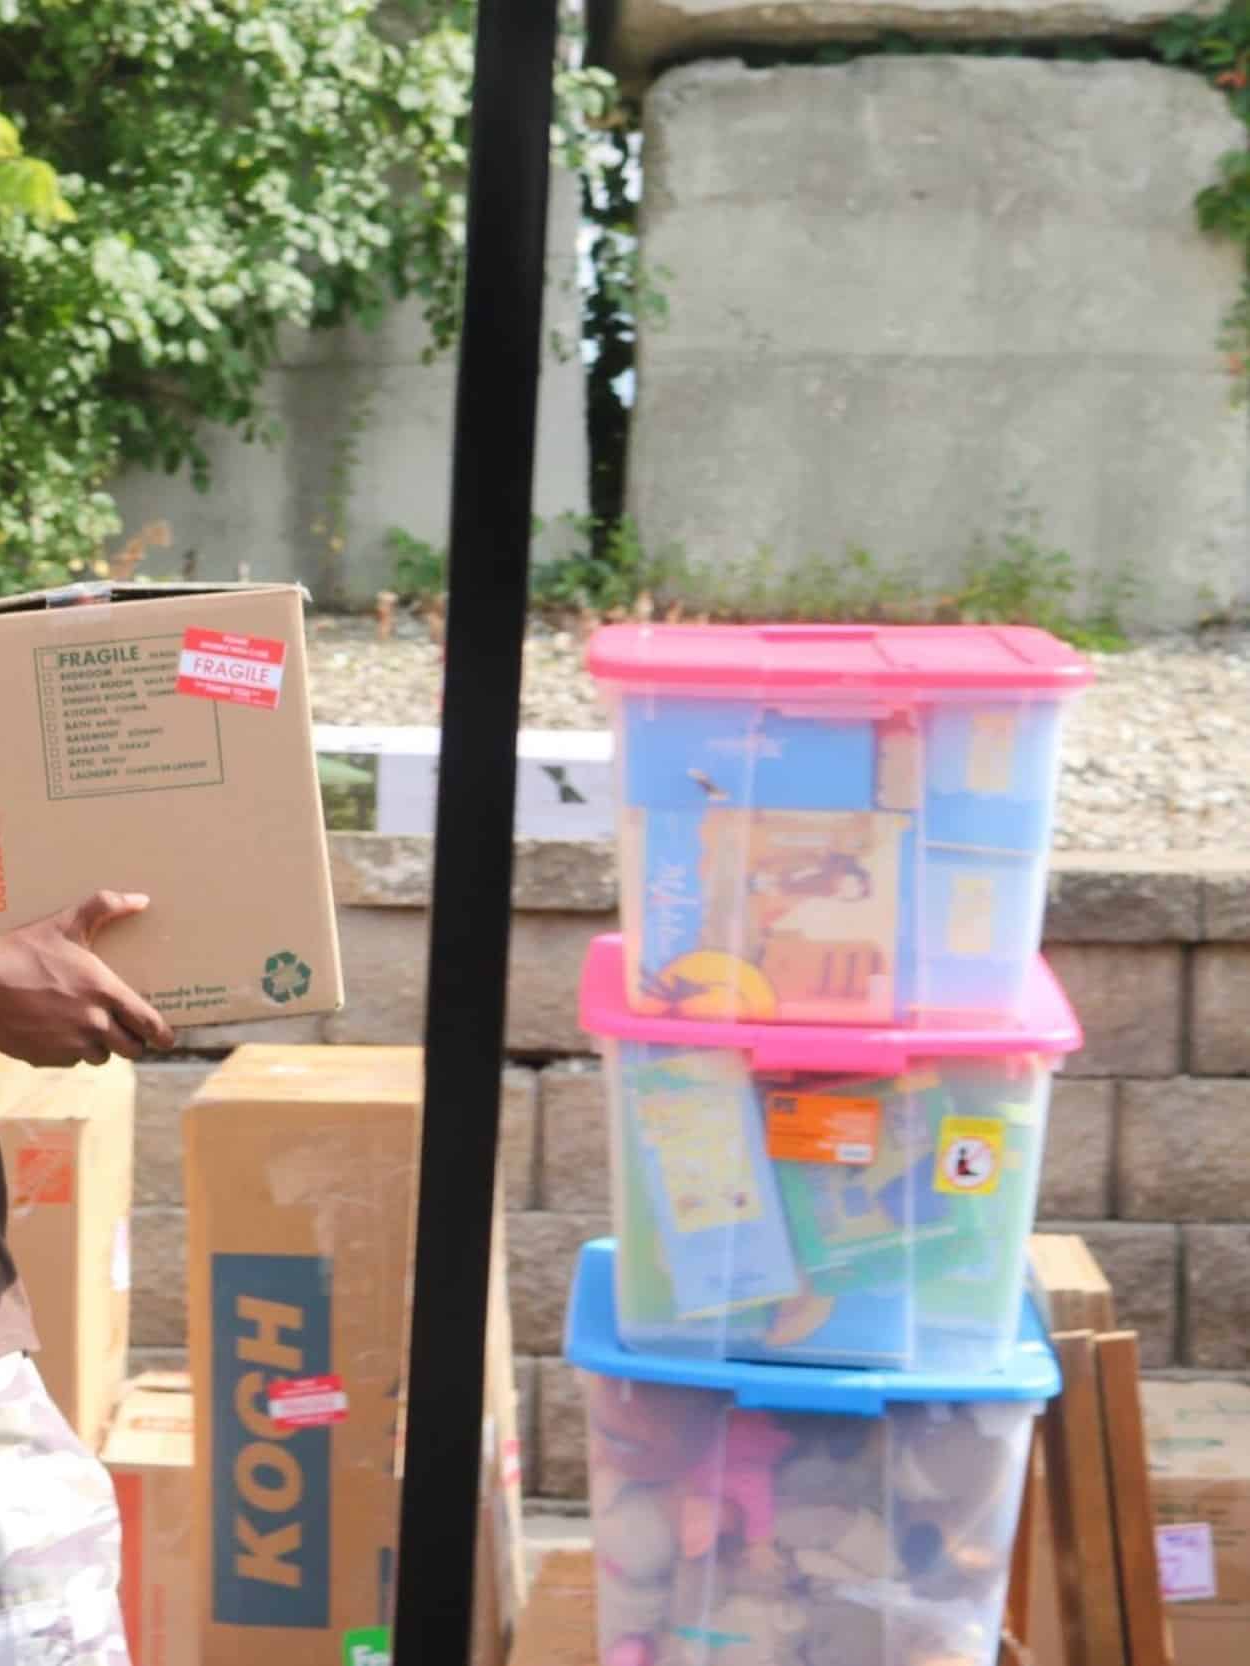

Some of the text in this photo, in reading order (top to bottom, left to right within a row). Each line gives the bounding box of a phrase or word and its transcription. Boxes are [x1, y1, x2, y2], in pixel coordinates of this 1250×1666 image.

[59, 646, 140, 667] FRAGILE
[193, 657, 271, 682] FRAGILE
[236, 1295, 305, 1590] KOCH
